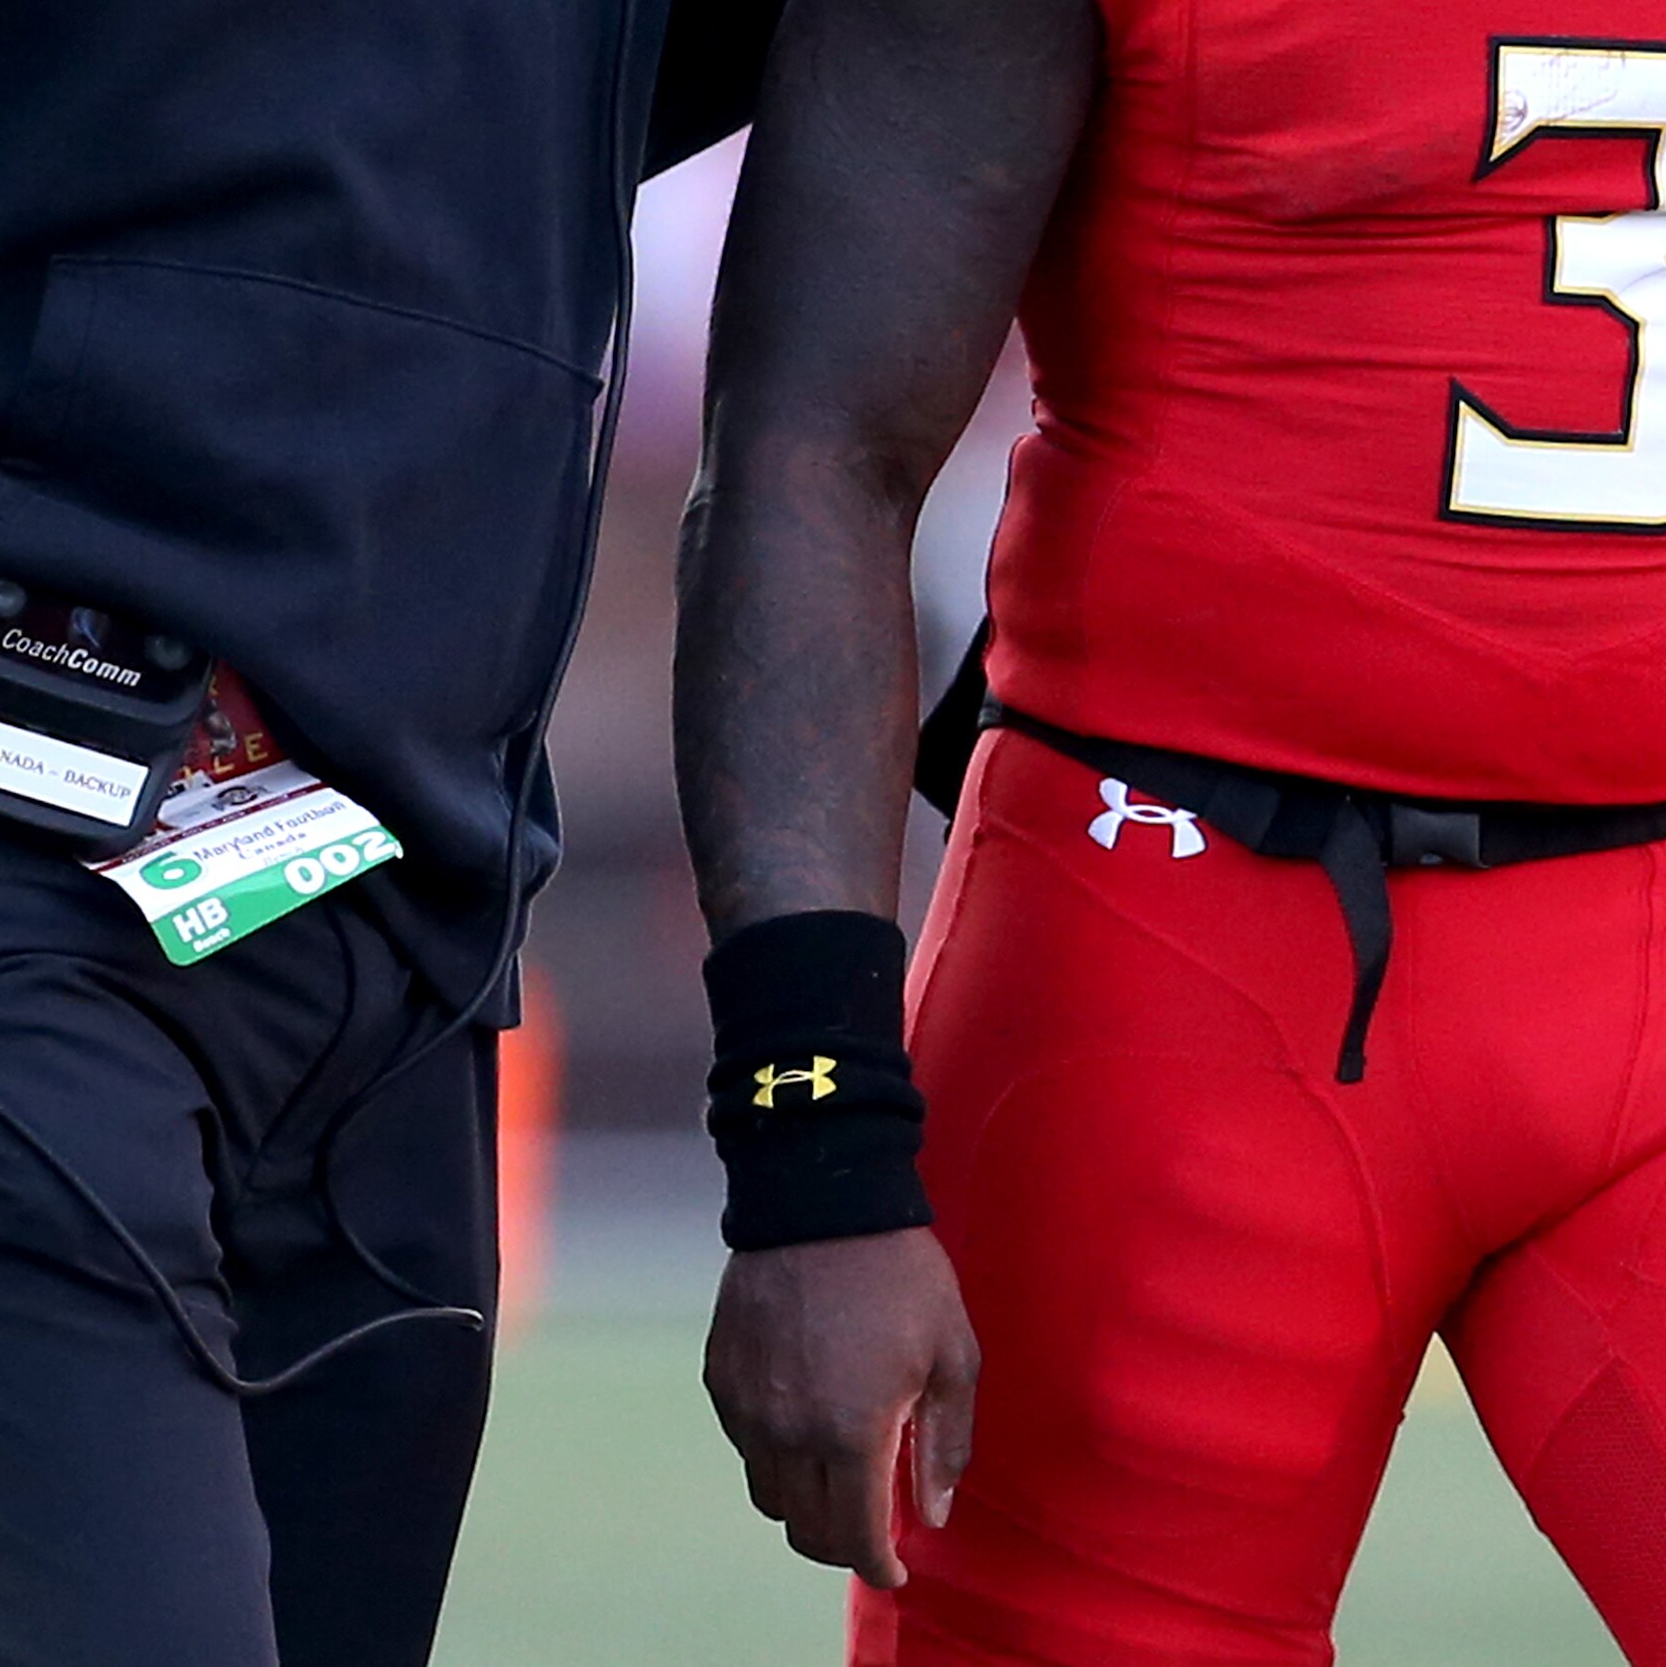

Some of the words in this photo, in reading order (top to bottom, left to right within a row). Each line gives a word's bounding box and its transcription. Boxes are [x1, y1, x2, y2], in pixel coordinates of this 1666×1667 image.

[1, 628, 142, 687] CoachComm
[63, 769, 132, 800] BACKUP
[192, 824, 275, 862] Maryland
[283, 831, 396, 895] 002
[172, 896, 230, 943] HB
